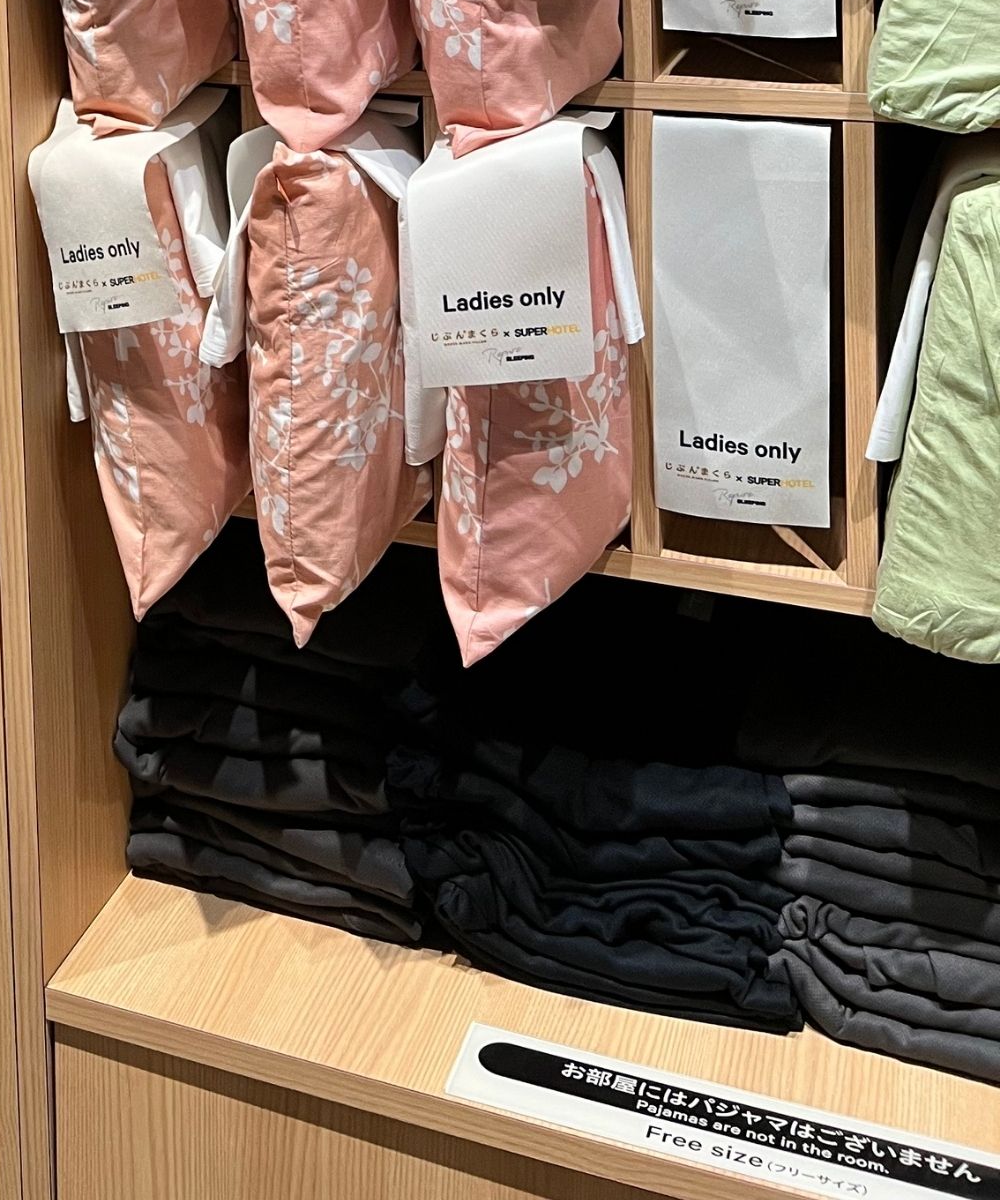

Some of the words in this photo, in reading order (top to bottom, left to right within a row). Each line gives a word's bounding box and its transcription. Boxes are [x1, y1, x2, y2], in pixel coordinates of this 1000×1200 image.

[60, 244, 104, 264] Ladies
[108, 237, 140, 258] only
[442, 291, 513, 313] Ladies
[519, 286, 565, 309] only
[514, 323, 581, 338] SUPERHOTEL
[680, 430, 749, 455] Ladies
[755, 442, 802, 464] only
[747, 476, 814, 488] SUPERHOTEL
[561, 1062, 982, 1183] お部屋にはパジャマはございません
[636, 1099, 708, 1127] Pajamas
[713, 1122, 741, 1135] are
[745, 1129, 776, 1145] not
[780, 1136, 797, 1150] in
[802, 1143, 832, 1159] the
[837, 1154, 890, 1174] room.
[646, 1125, 702, 1151] Free
[711, 1145, 763, 1168] size
